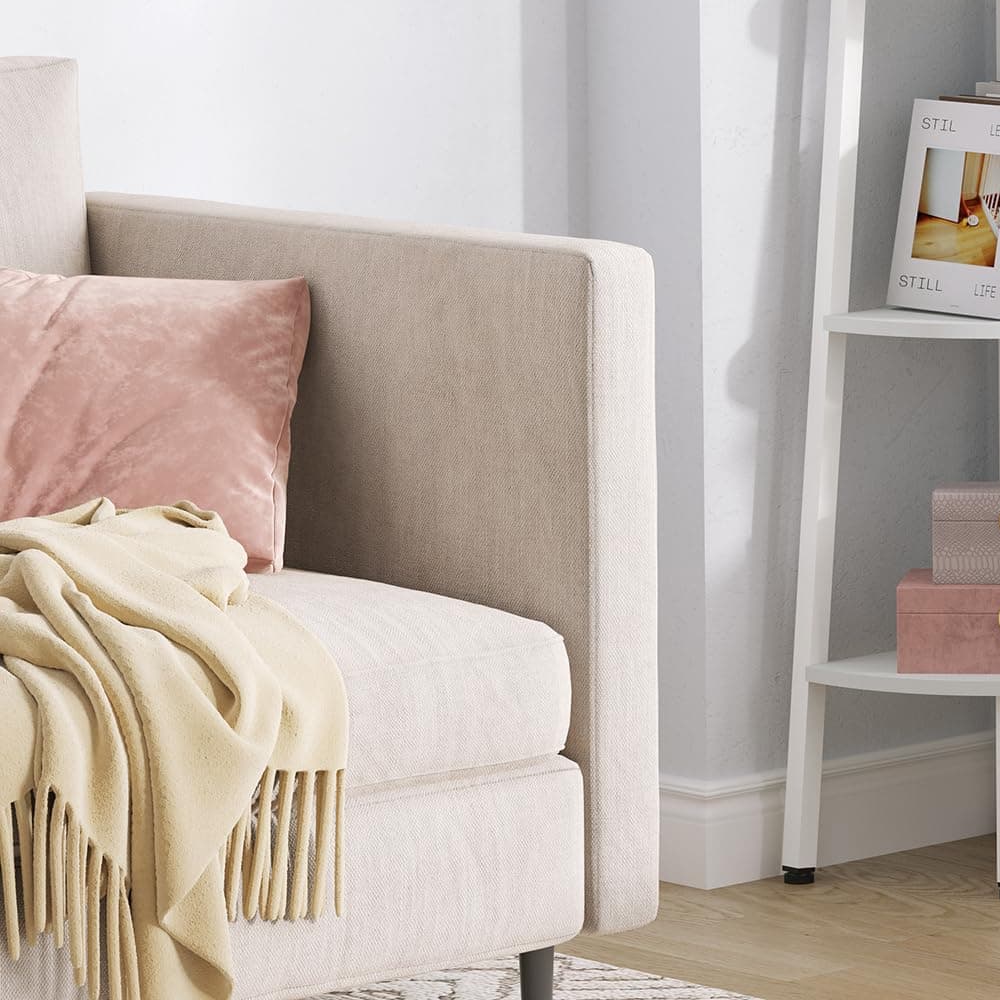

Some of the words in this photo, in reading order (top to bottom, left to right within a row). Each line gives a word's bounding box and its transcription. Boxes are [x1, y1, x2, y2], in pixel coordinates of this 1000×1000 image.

[921, 117, 956, 132] STIL
[899, 275, 942, 292] STILL
[974, 283, 997, 298] LIFE
